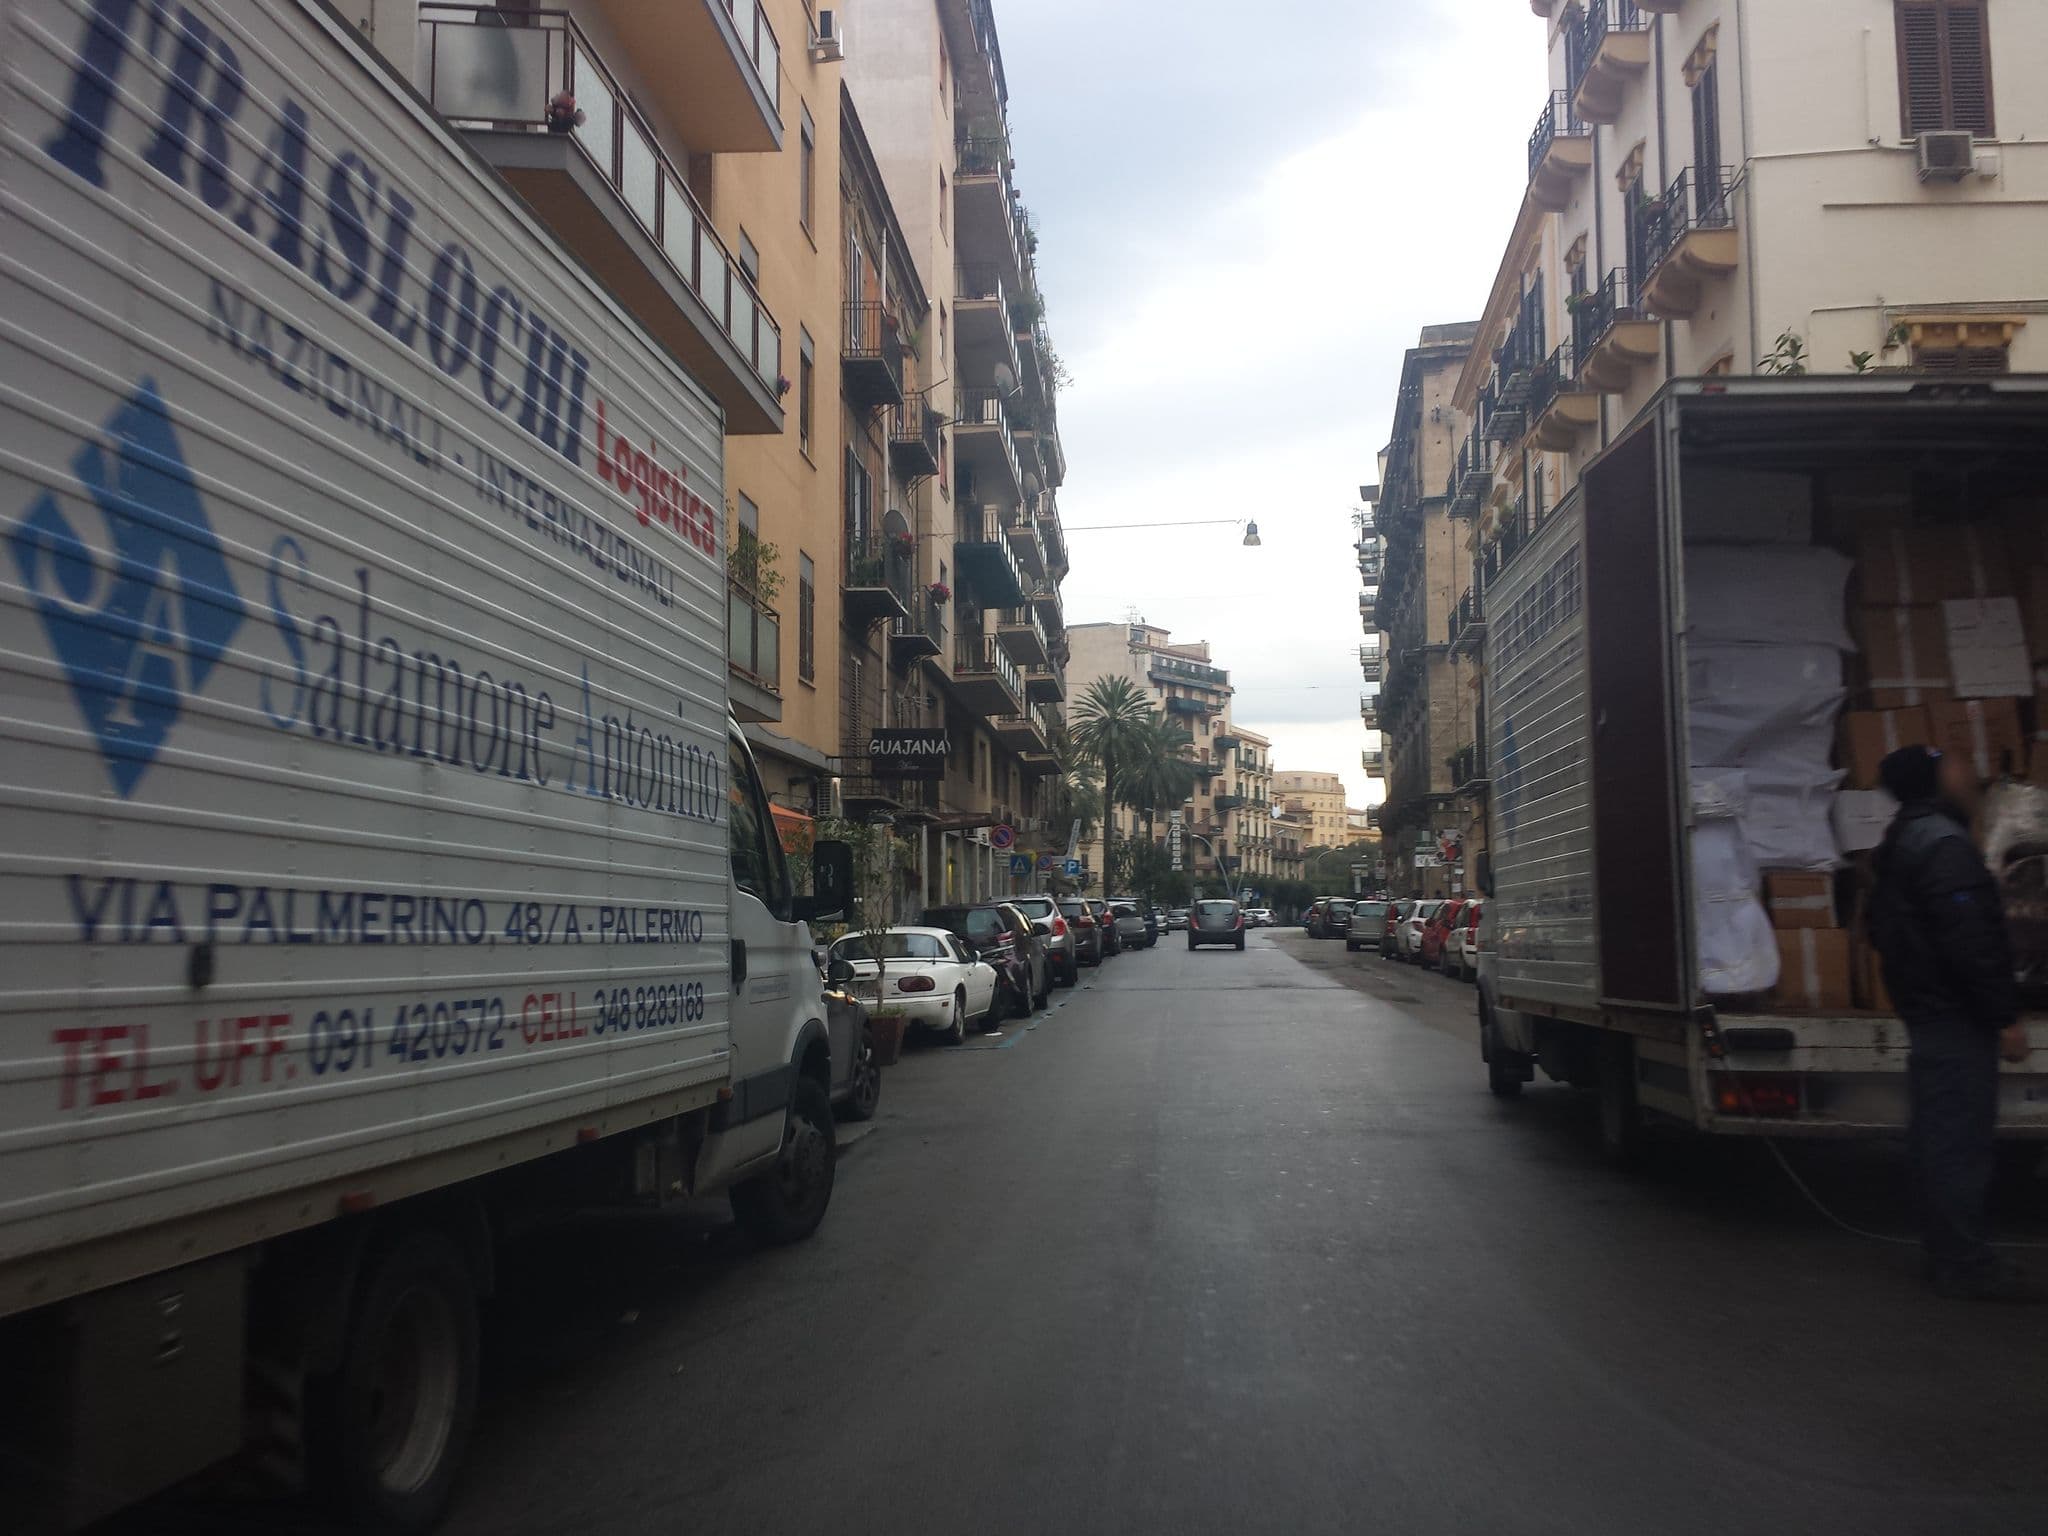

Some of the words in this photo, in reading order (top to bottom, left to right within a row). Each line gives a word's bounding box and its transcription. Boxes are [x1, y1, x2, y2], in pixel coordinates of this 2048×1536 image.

[40, 0, 592, 468] TRASLOCHI
[596, 400, 716, 556] Logistica
[206, 276, 444, 472] NAZIONALI
[475, 447, 674, 608] INTERNAZIONALI
[260, 535, 556, 786] Salamone
[566, 656, 720, 823] Antonino
[869, 739, 947, 755] GUAJANA
[65, 873, 187, 943] VIA
[206, 883, 496, 948] PALMERINO,
[504, 902, 582, 944] 48/A
[600, 906, 703, 944] PALERMO
[194, 1013, 298, 1092] UFF.
[307, 1007, 375, 1075] 091
[388, 997, 505, 1062] 420572
